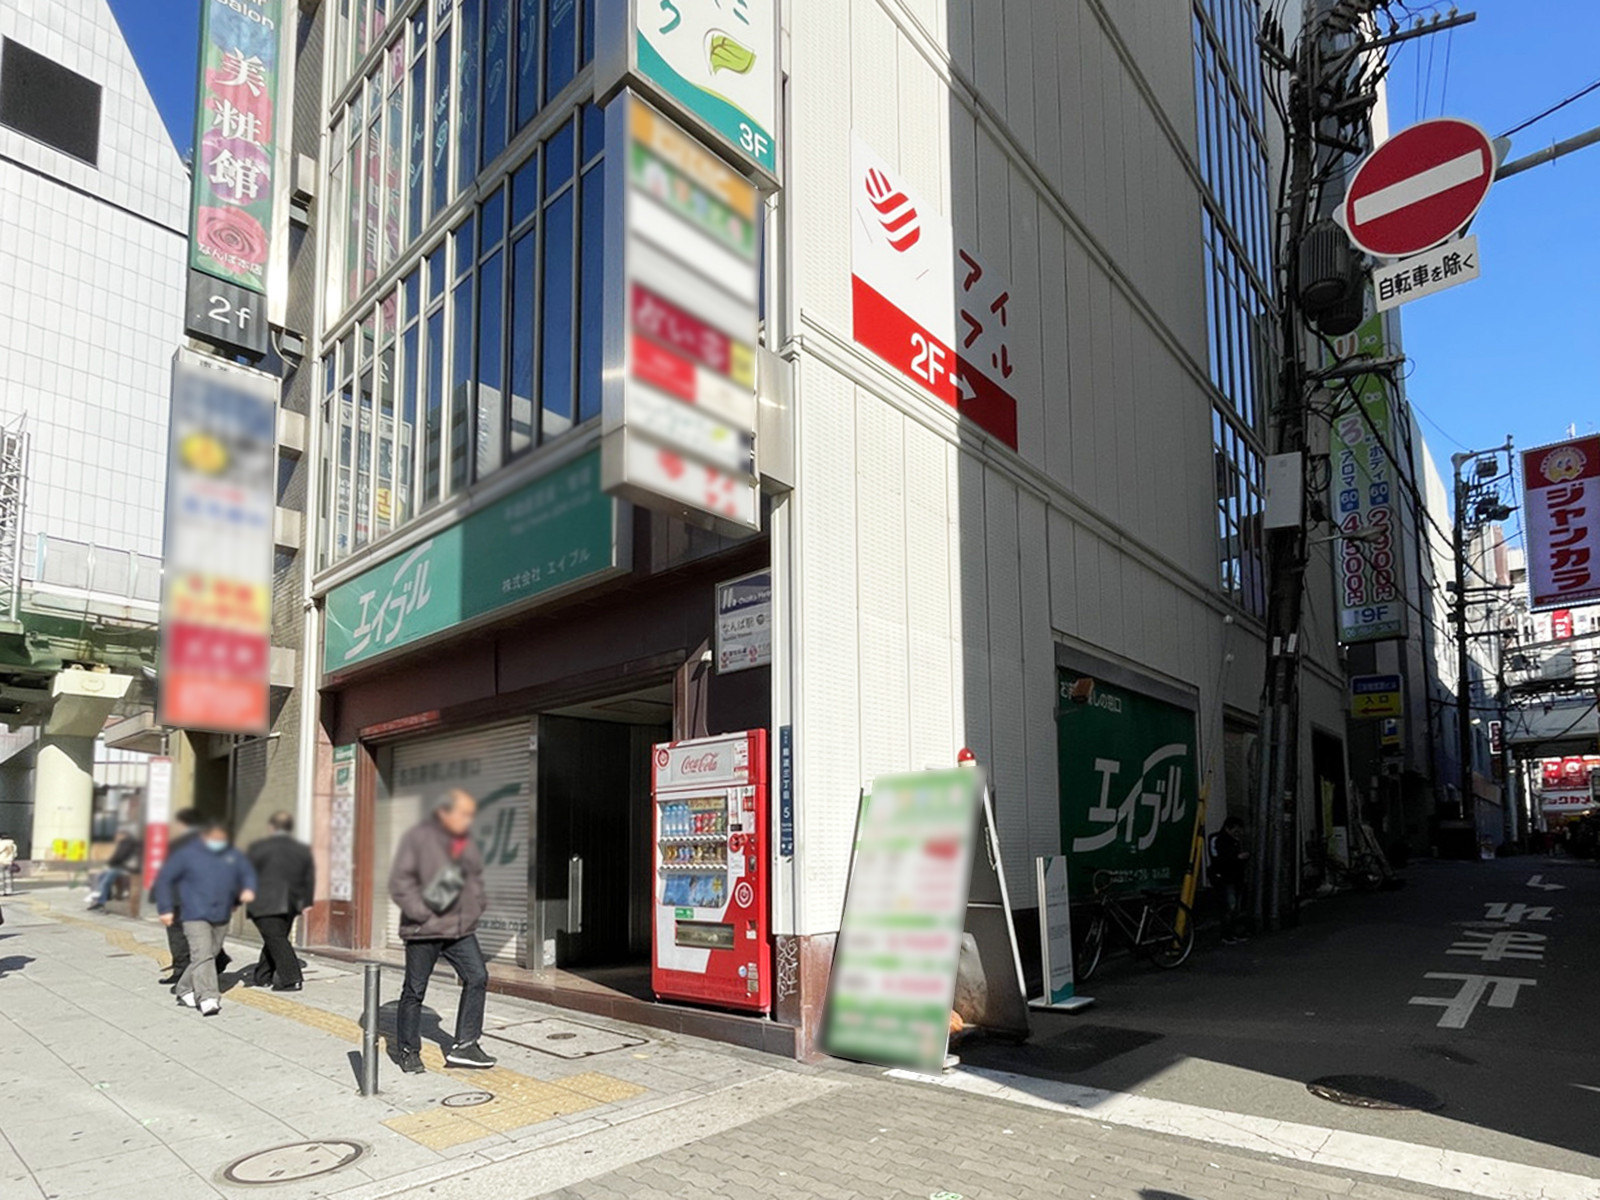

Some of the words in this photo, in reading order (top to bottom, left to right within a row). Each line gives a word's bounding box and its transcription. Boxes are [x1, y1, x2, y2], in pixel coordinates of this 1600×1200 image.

[217, 0, 274, 30] alon
[209, 46, 266, 199] 美粧館
[739, 122, 768, 157] 3F
[1379, 252, 1475, 301] 自転車を除く
[208, 295, 252, 329] 2f
[910, 332, 945, 385] 2F
[1341, 450, 1355, 487] アロマ
[1547, 482, 1592, 591] ジャンカラ
[502, 568, 541, 592] 株式会社
[547, 548, 591, 575] エイブル
[344, 538, 434, 660] エイブル
[1361, 606, 1389, 623] 9F
[1556, 616, 1569, 637] Tax
[783, 806, 790, 818] 5
[1073, 744, 1187, 852] エイブル
